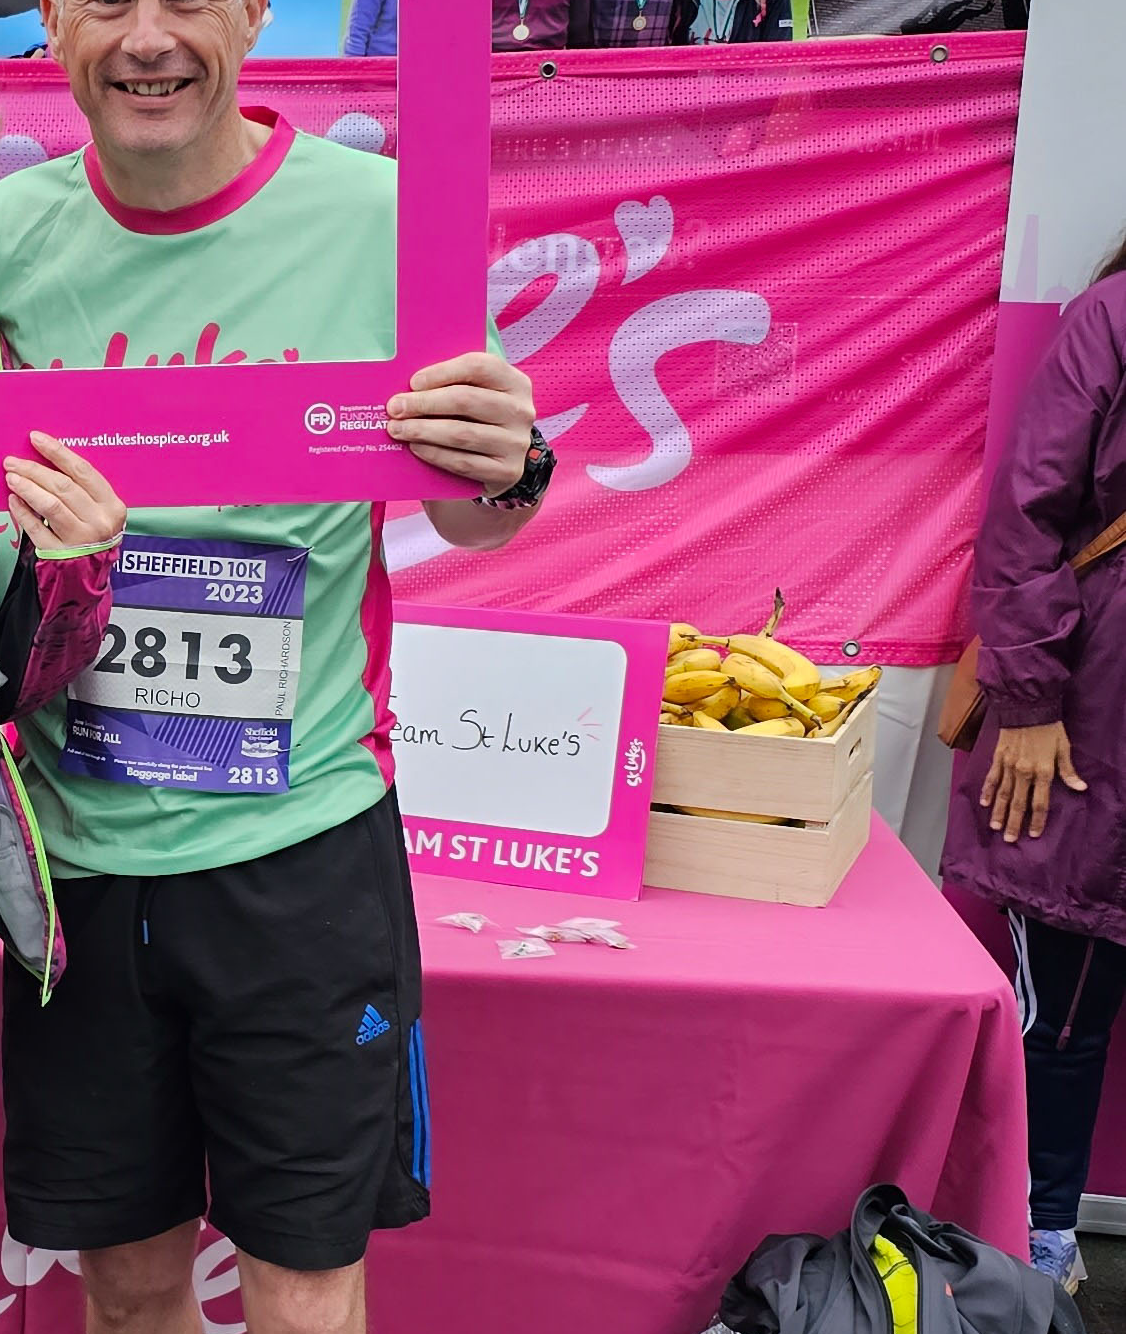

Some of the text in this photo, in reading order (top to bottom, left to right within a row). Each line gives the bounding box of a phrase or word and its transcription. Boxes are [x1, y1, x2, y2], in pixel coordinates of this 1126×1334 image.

[310, 413, 331, 426] FR
[339, 420, 388, 431] REGULAT
[340, 412, 388, 421] FUNDRAIS
[125, 553, 263, 579] SHEFFIELD 10K
[205, 582, 264, 604] 2023
[93, 623, 253, 684] 2813
[275, 621, 291, 716] PAUL RICHARDSON
[135, 687, 201, 708] RICHO
[103, 732, 122, 745] ALL
[389, 721, 444, 745] eam
[452, 709, 494, 751] St
[126, 766, 198, 782] Baggage label
[227, 767, 279, 785] 2813
[449, 834, 488, 863] ST
[493, 839, 600, 877] LUKE'S
